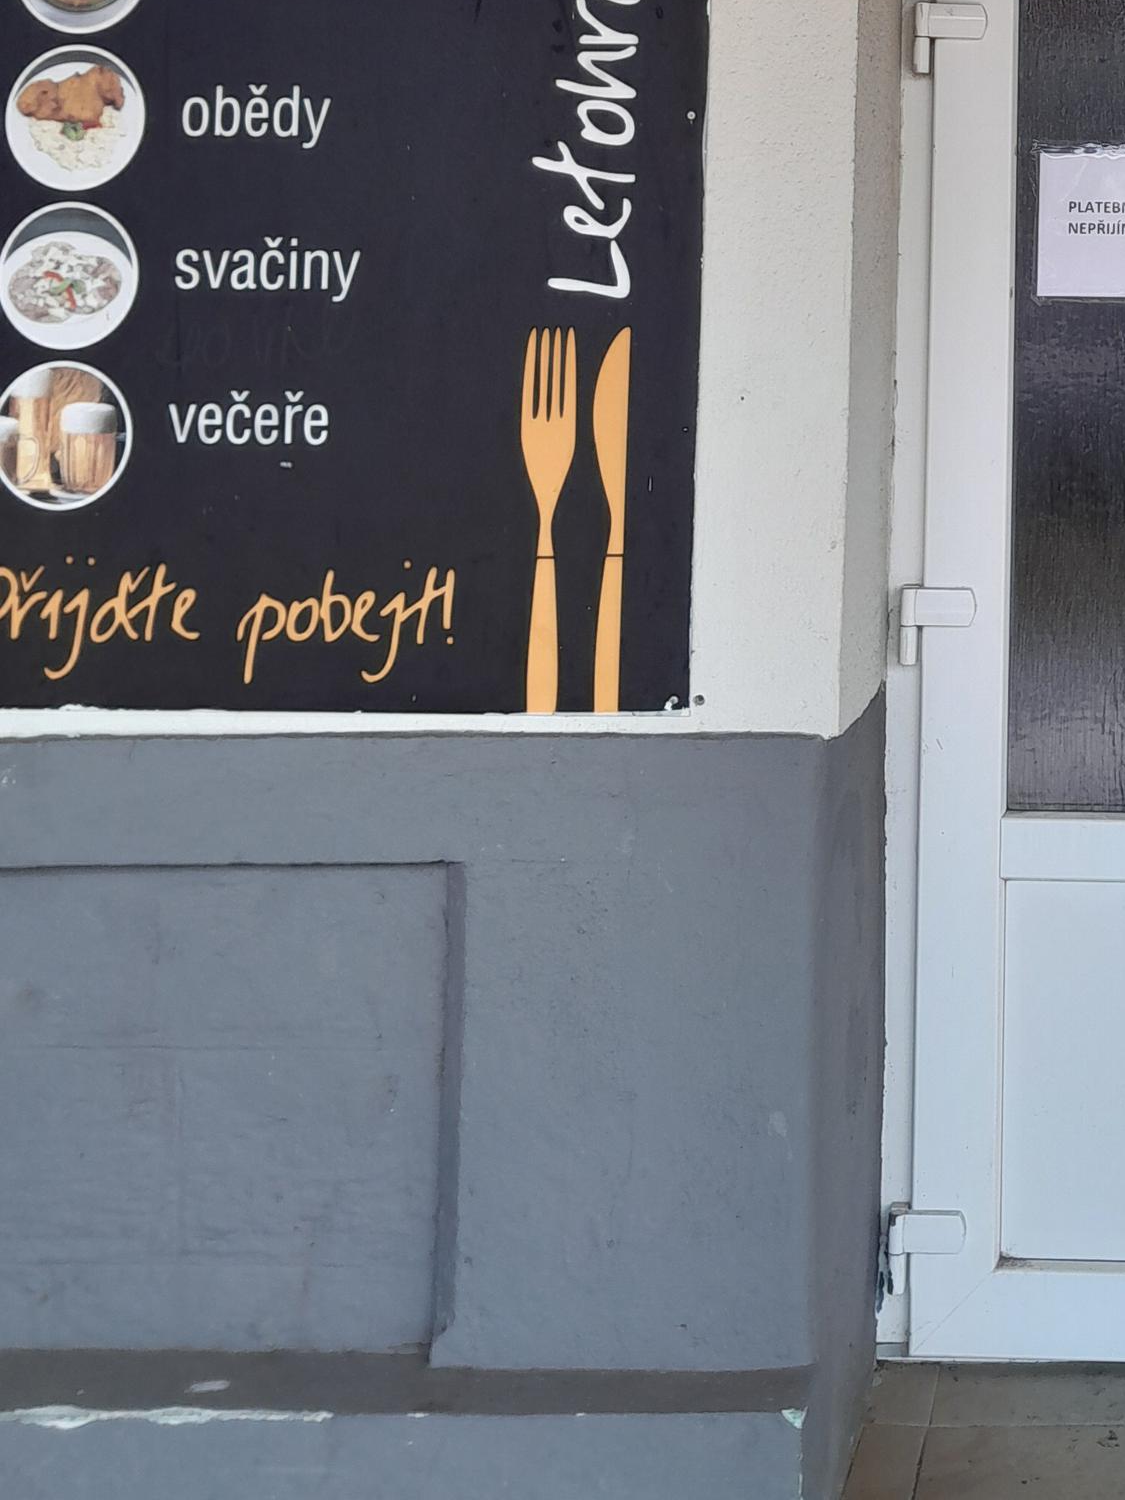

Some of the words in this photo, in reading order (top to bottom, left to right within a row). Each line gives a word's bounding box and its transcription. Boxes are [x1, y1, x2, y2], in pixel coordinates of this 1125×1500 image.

[181, 84, 333, 149] obědy
[173, 236, 361, 303] svačiny
[168, 389, 330, 447] večeře
[236, 560, 456, 685] pobejt!
